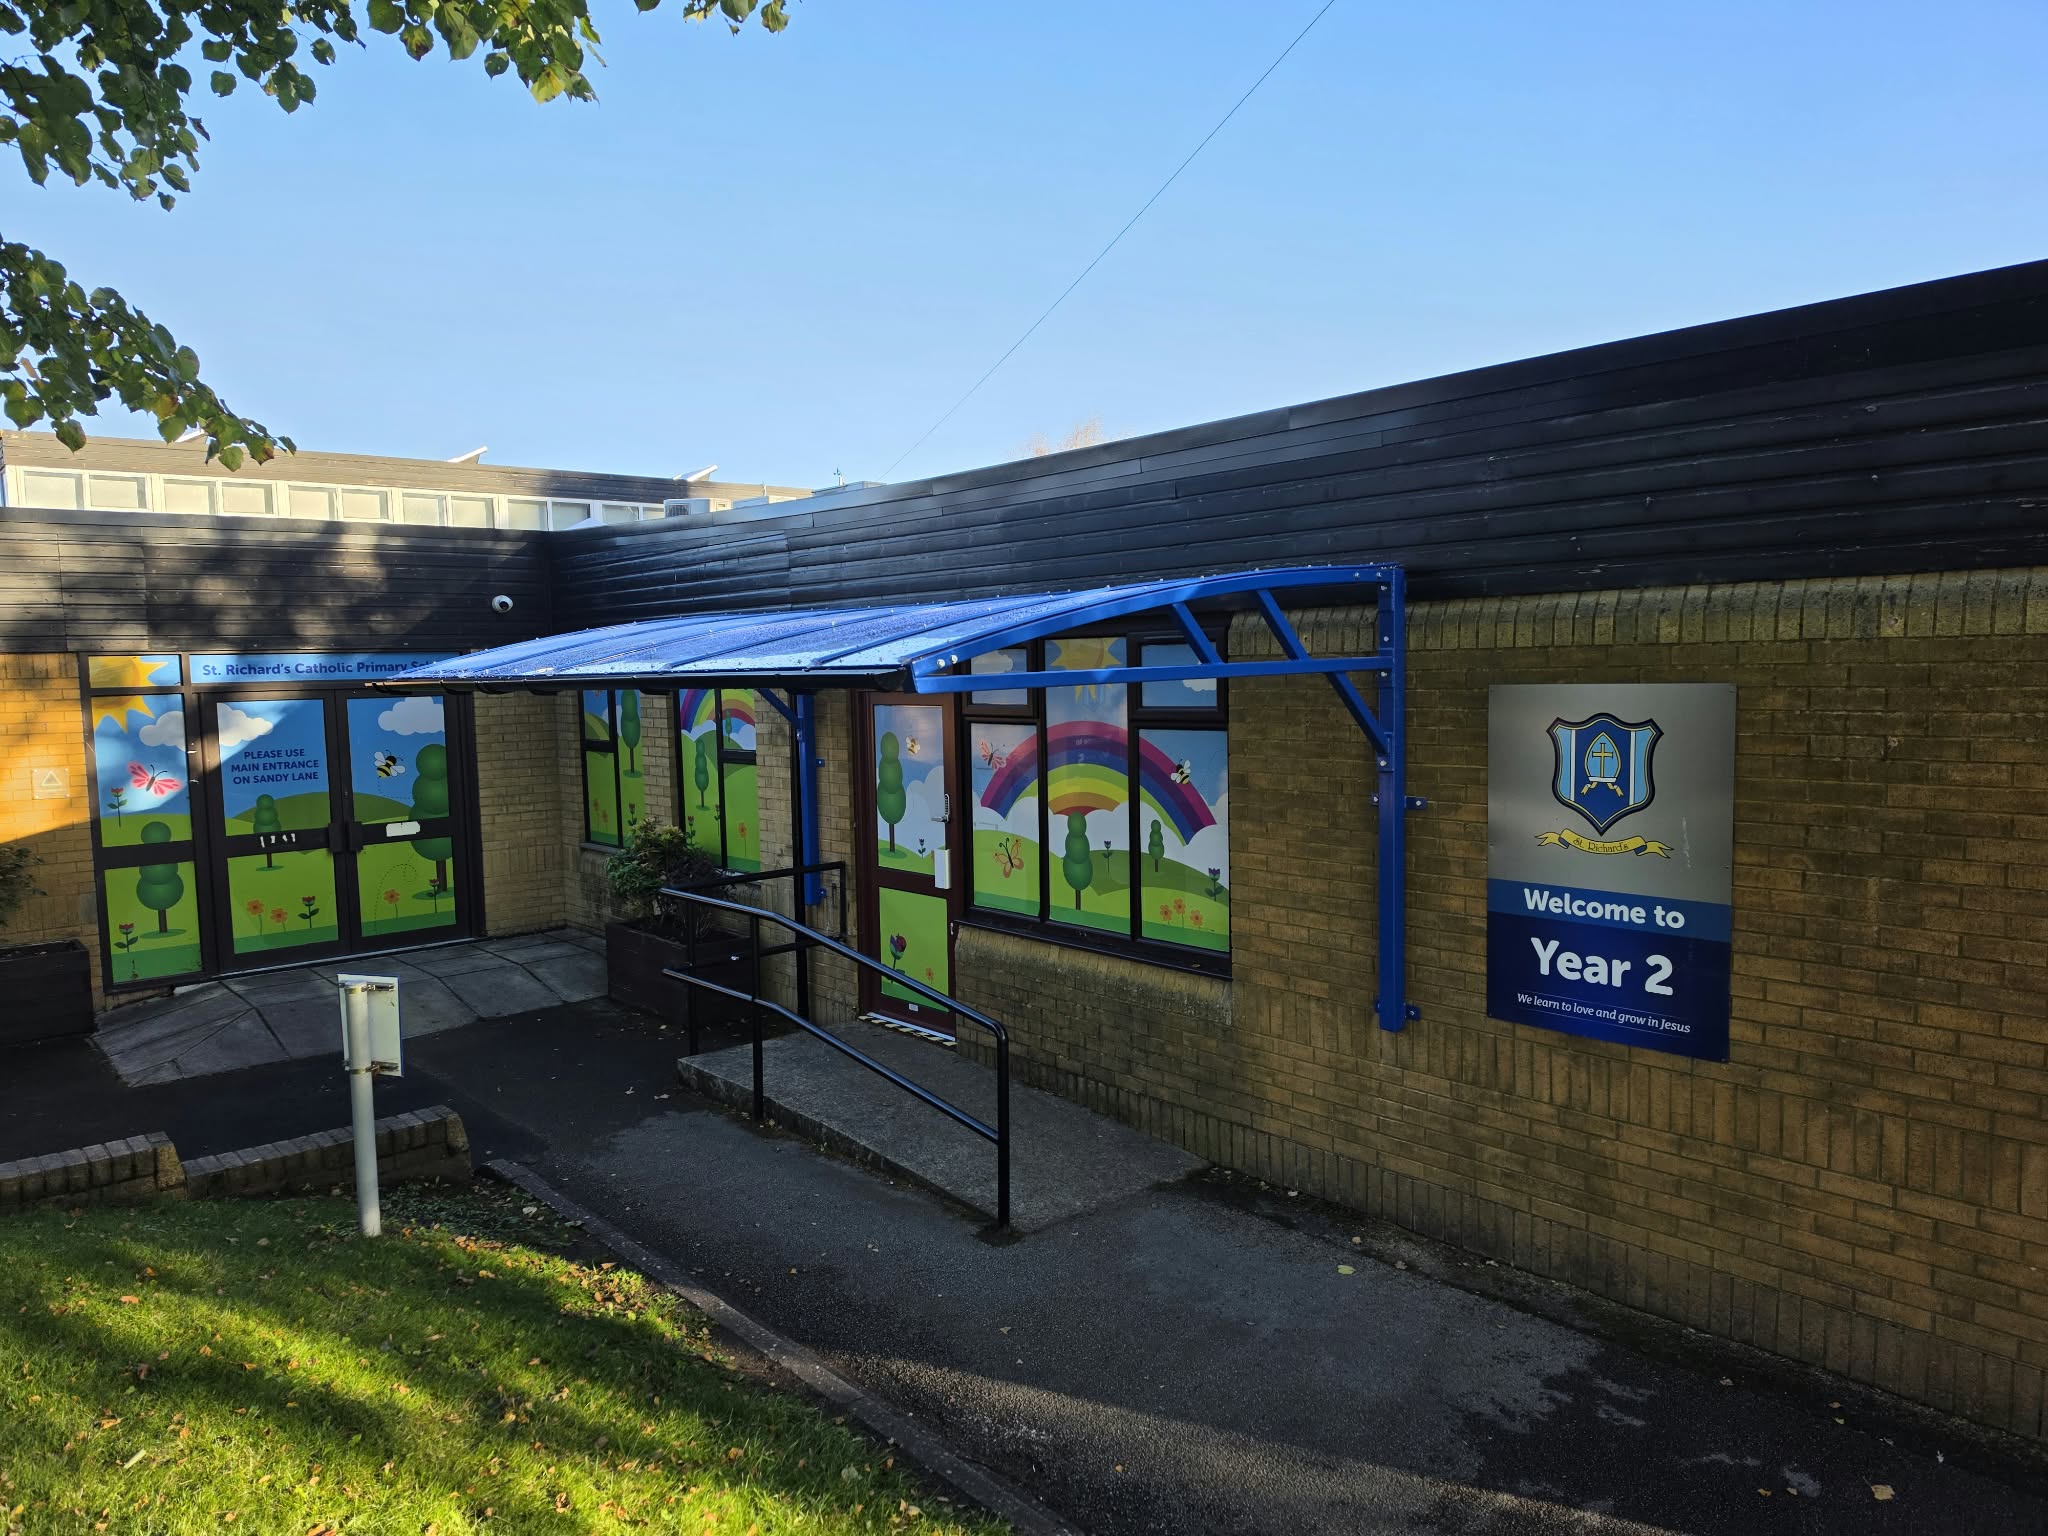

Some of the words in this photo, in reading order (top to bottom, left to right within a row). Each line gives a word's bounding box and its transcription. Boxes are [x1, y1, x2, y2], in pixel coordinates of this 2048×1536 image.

[203, 664, 221, 676] St.
[226, 663, 291, 676] Richard's
[295, 661, 353, 674] Catholic
[357, 661, 408, 673] Primary
[244, 750, 283, 760] PLEASE
[285, 748, 305, 758] USE
[231, 762, 260, 773] MAIN
[262, 760, 320, 771] ENTRANCE
[233, 775, 251, 785] ON
[253, 773, 290, 784] SANDY
[292, 771, 320, 781] LANE
[1588, 842, 1630, 853] Richard's
[1523, 887, 1646, 924] Welcome
[1653, 906, 1685, 929] to
[1530, 937, 1631, 988] Year
[1644, 954, 1674, 996] 2
[1517, 993, 1533, 1004] We
[1534, 995, 1560, 1010] learn
[1561, 1001, 1572, 1012] to
[1573, 1003, 1594, 1016] love
[1596, 1008, 1617, 1020] and
[1618, 1013, 1646, 1025] grow
[1647, 1016, 1659, 1028] in
[1659, 1019, 1691, 1034] Jesus
